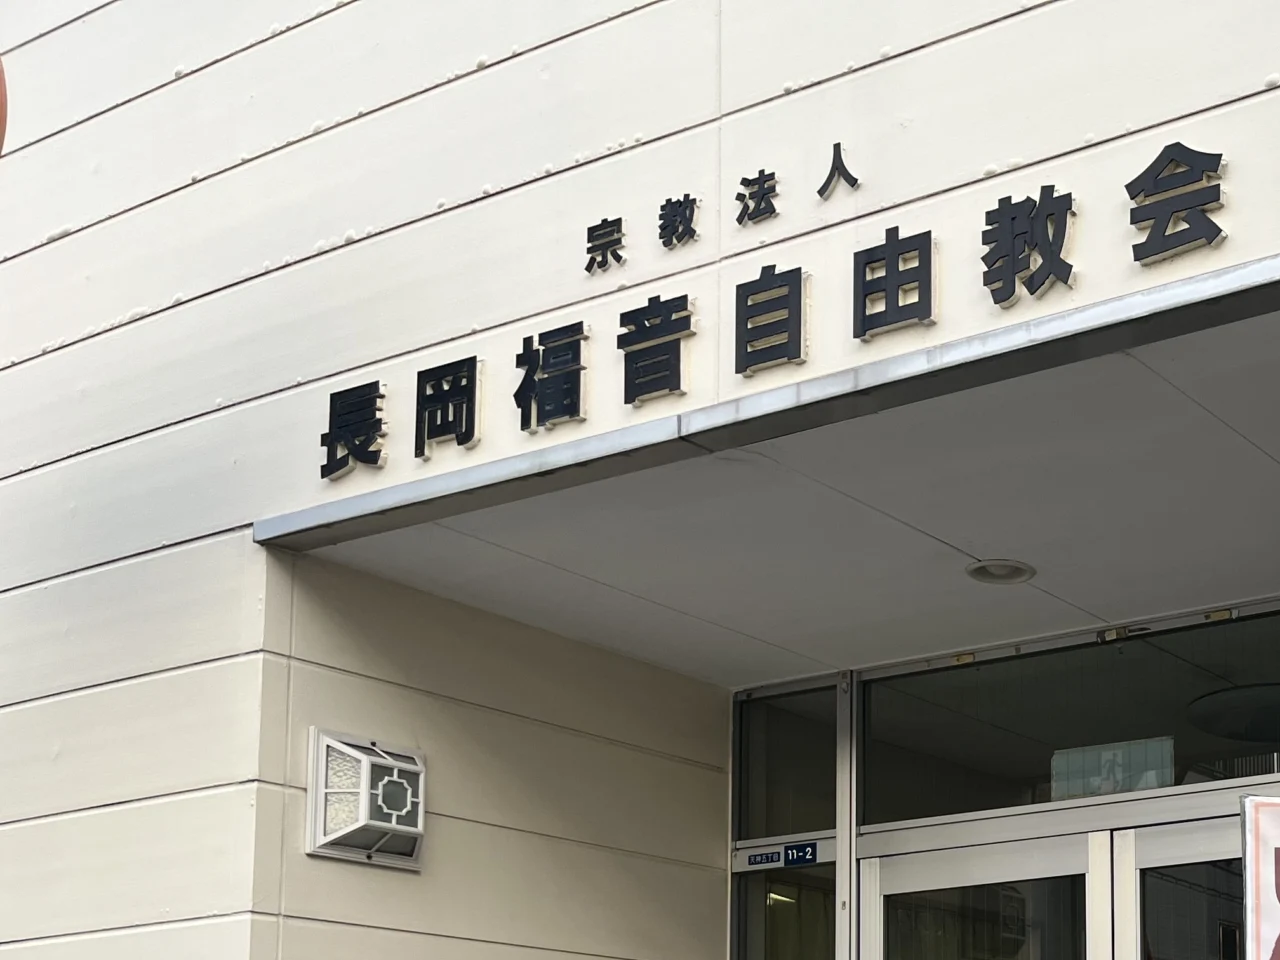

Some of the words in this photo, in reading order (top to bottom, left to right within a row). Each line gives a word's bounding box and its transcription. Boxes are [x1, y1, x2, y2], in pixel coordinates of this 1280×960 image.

[585, 142, 860, 275] 宗教法人
[320, 141, 1226, 480] 長岡福音自由教会
[787, 847, 812, 860] 11-2
